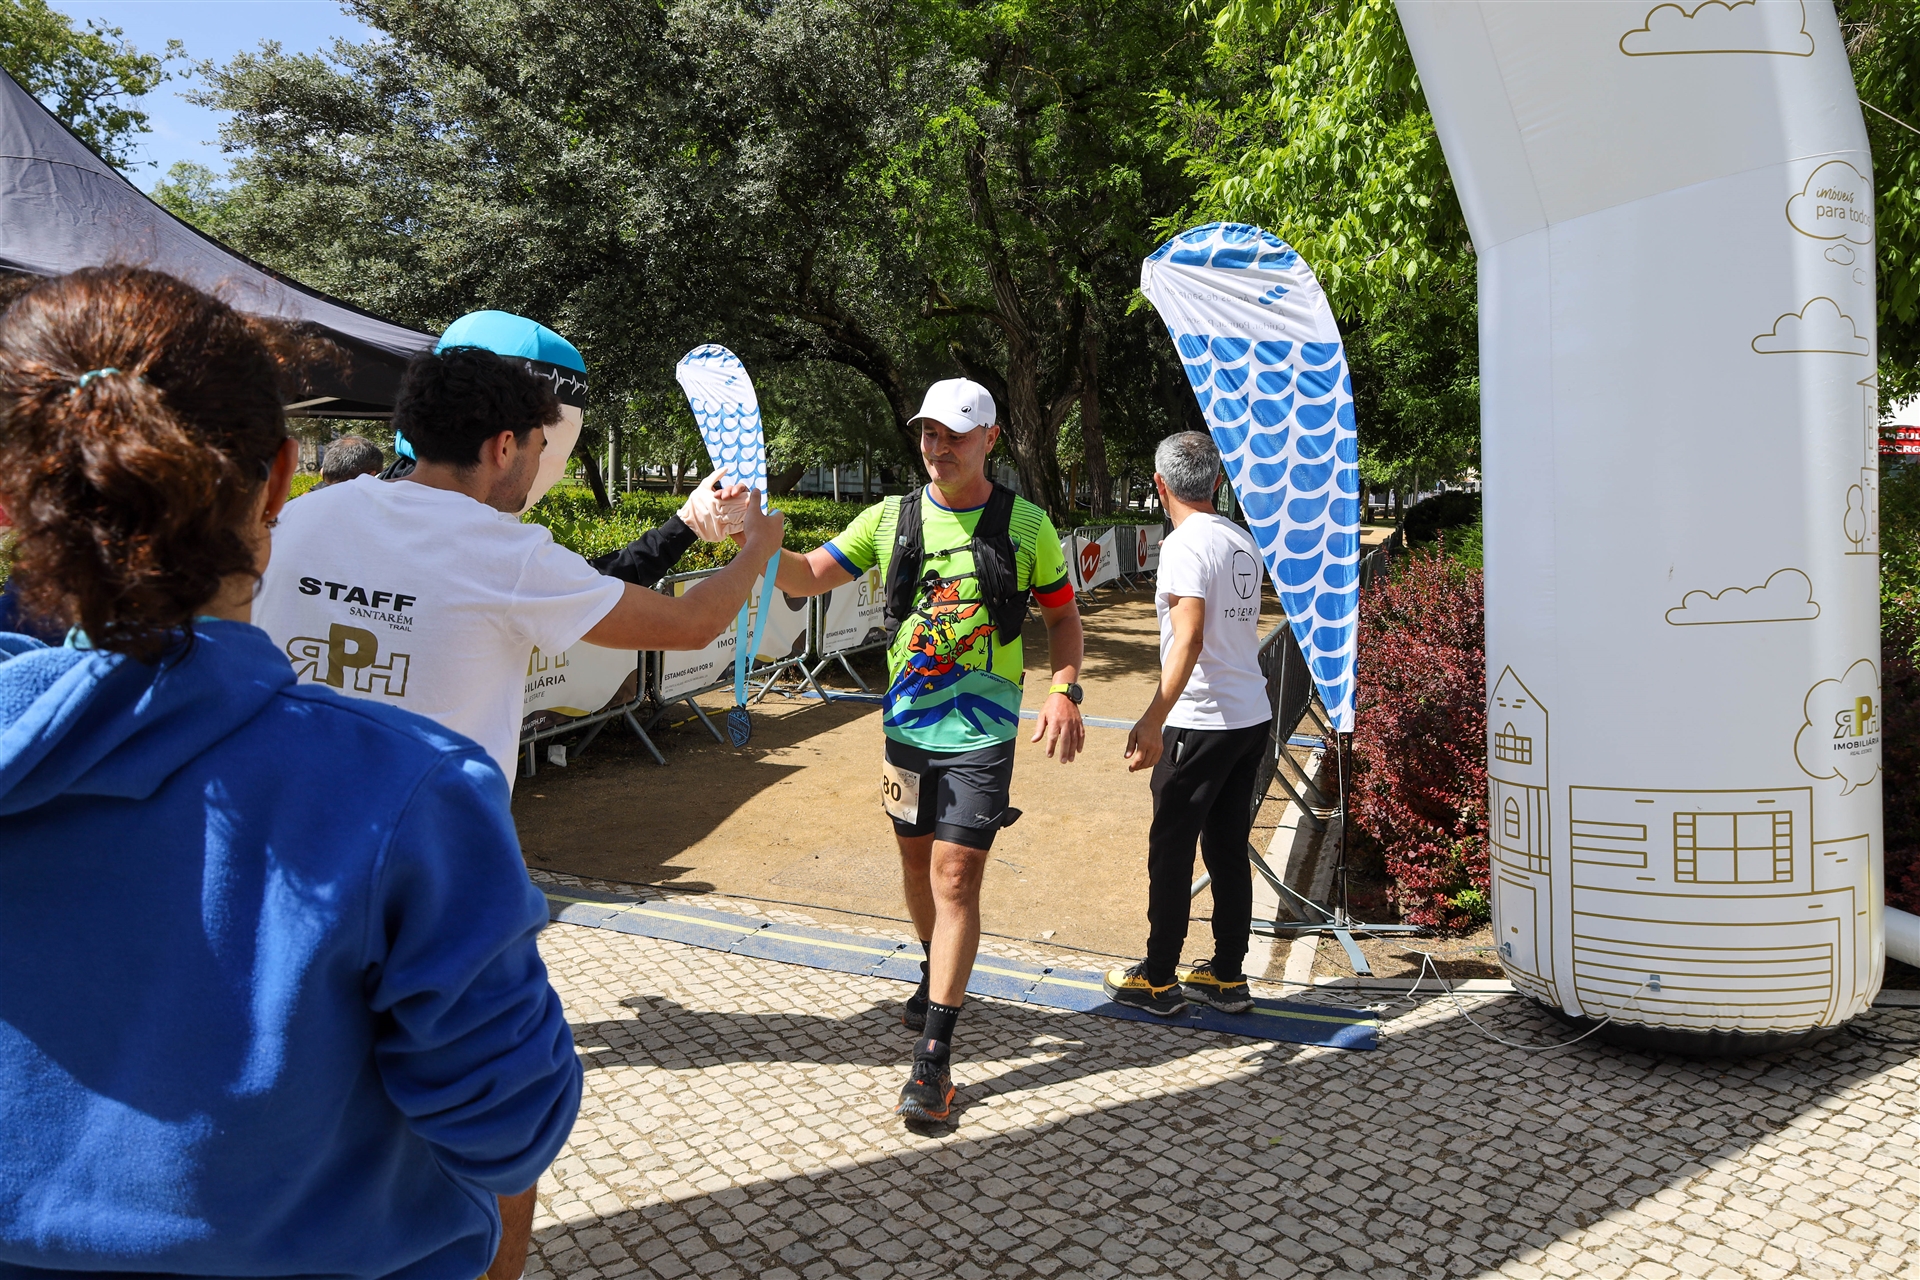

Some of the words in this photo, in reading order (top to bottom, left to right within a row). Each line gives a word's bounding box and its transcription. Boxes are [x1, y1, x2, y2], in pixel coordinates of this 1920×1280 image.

[1816, 185, 1855, 204] imóveis
[1816, 205, 1846, 220] para
[1849, 207, 1871, 227] todos
[298, 576, 417, 612] STAFF
[349, 606, 414, 626] SANTARÉM
[389, 623, 412, 632] TRAIL
[664, 668, 687, 681] ESTAMOS
[687, 665, 699, 675] AQUI
[699, 663, 708, 671] POR
[709, 661, 714, 669] SI
[1833, 736, 1880, 751] IMOBILIÁRIA
